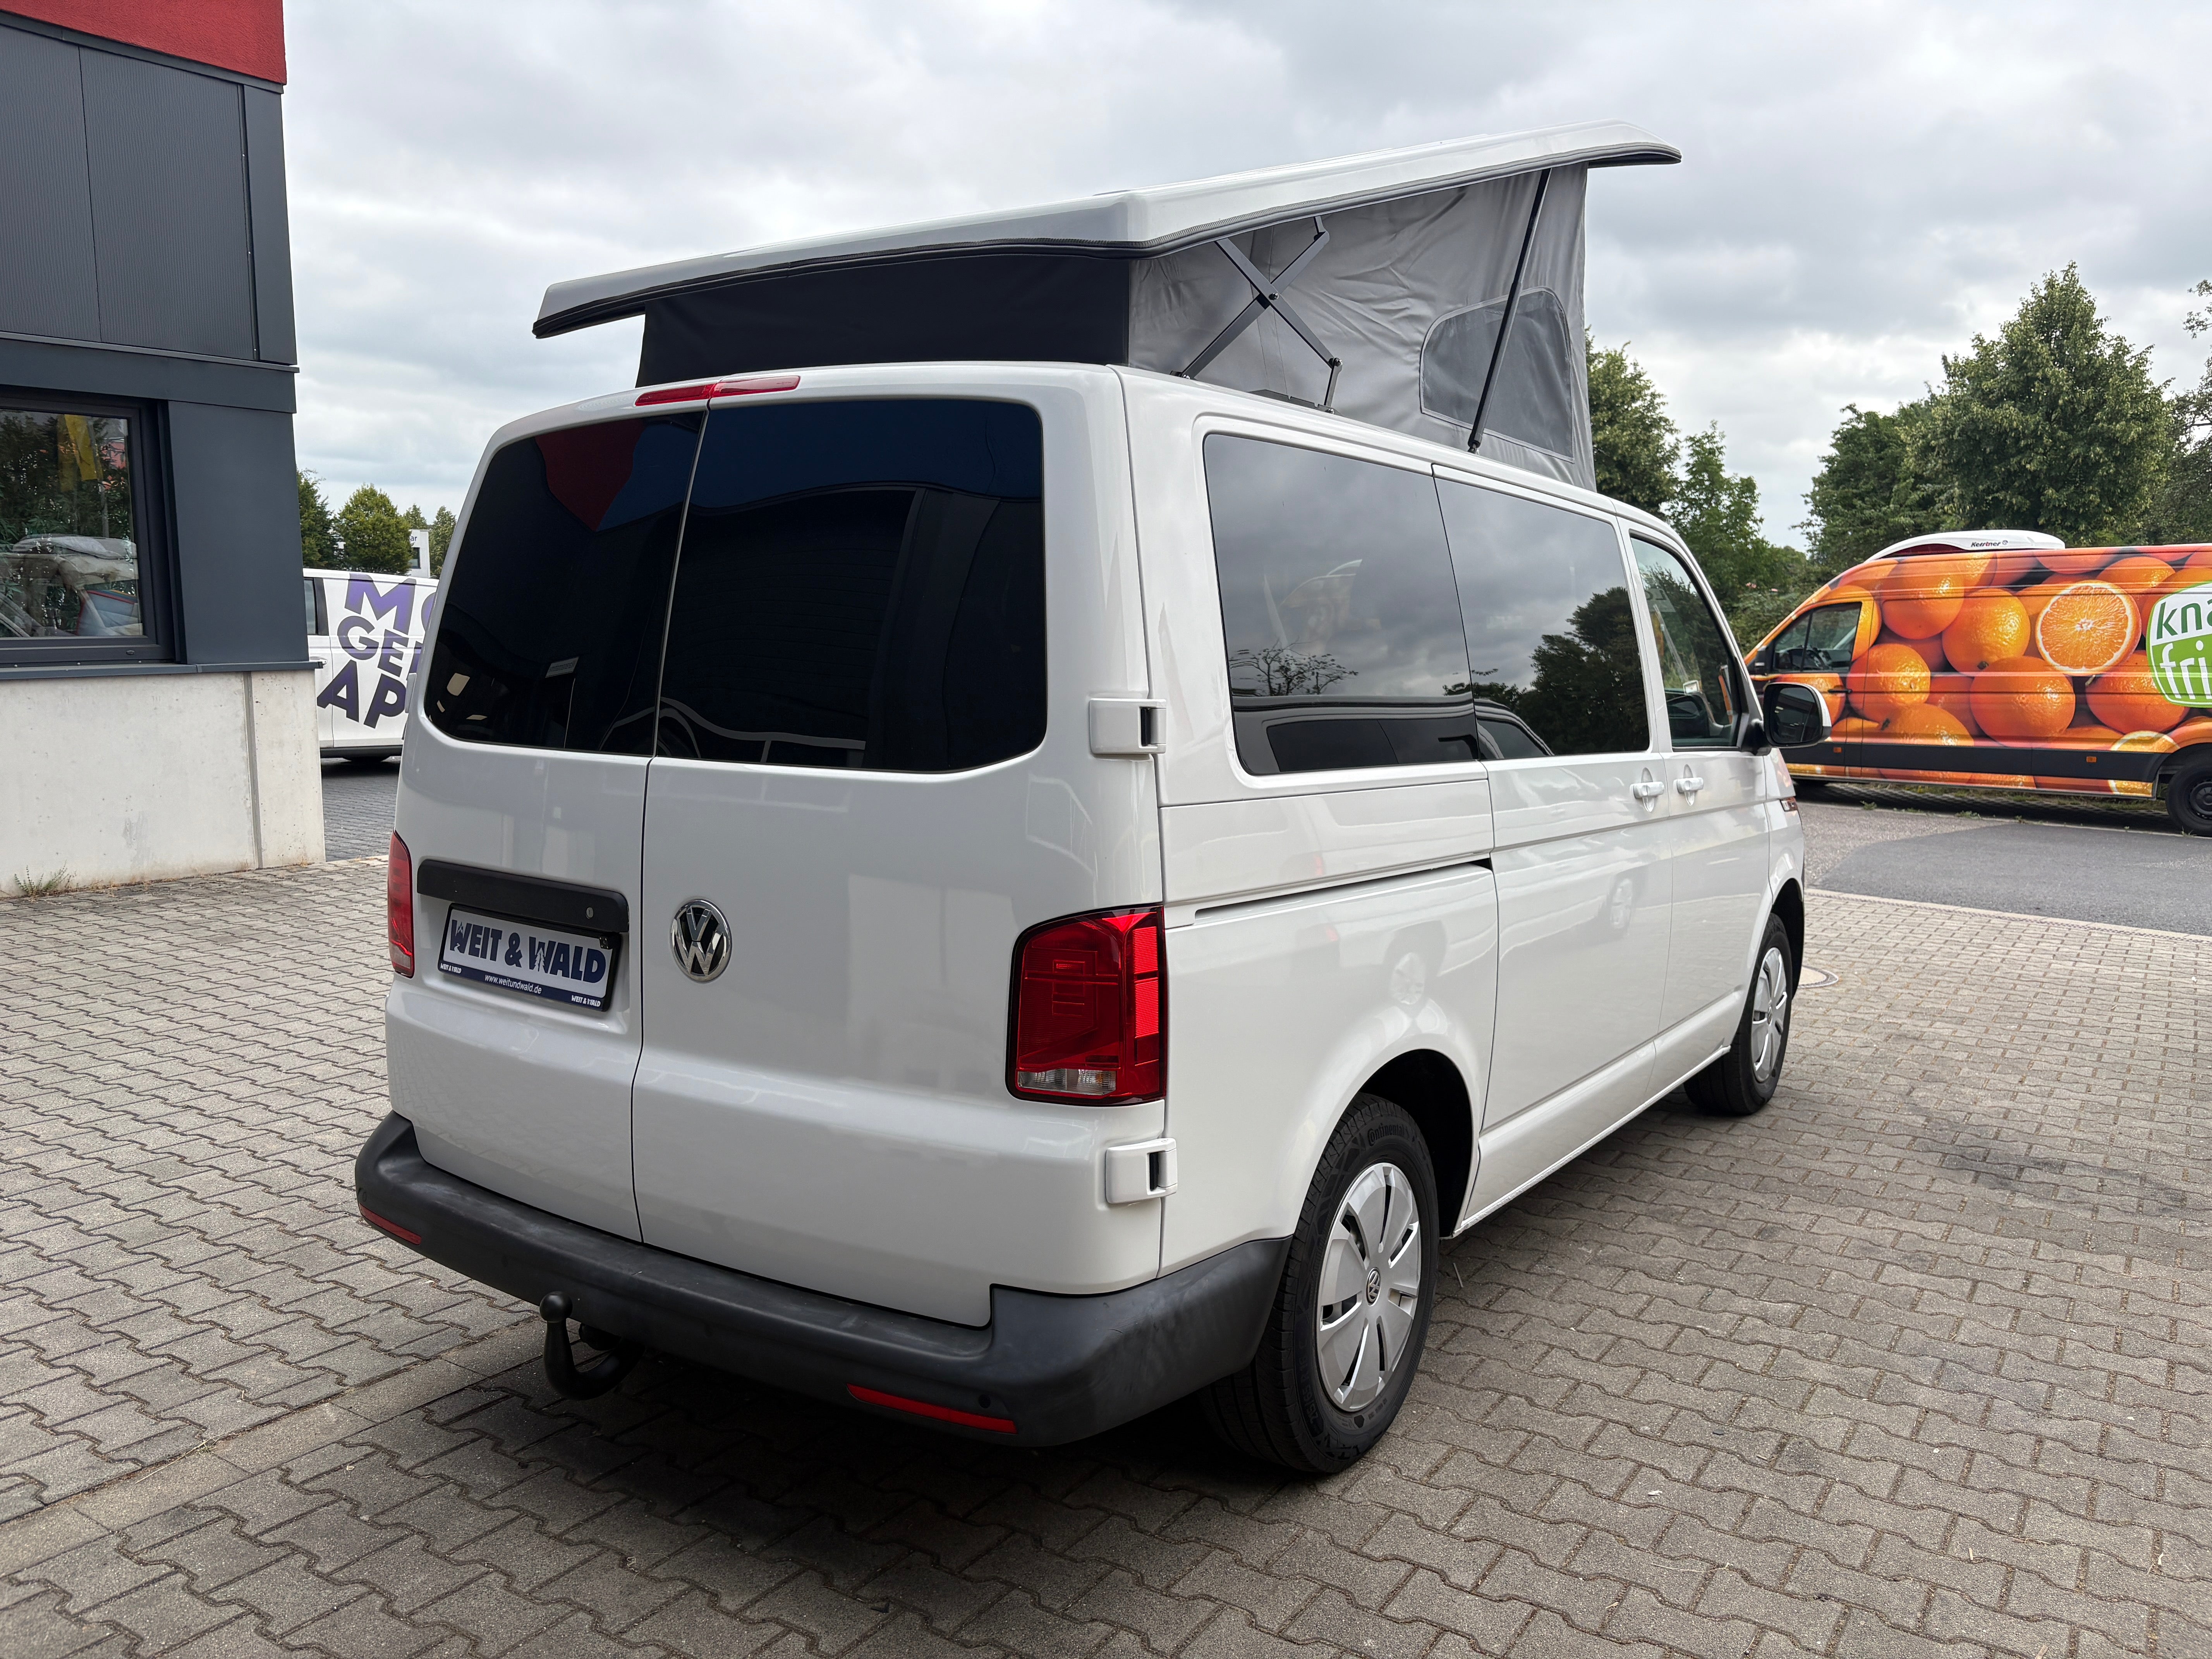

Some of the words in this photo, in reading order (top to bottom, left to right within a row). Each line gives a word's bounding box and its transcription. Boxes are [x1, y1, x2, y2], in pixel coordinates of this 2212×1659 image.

[450, 919, 503, 962] WEIT
[505, 932, 522, 968] &
[529, 936, 606, 983] WALD
[485, 974, 541, 994] www.weitundwald.de
[1367, 1123, 1404, 1146] Continental
